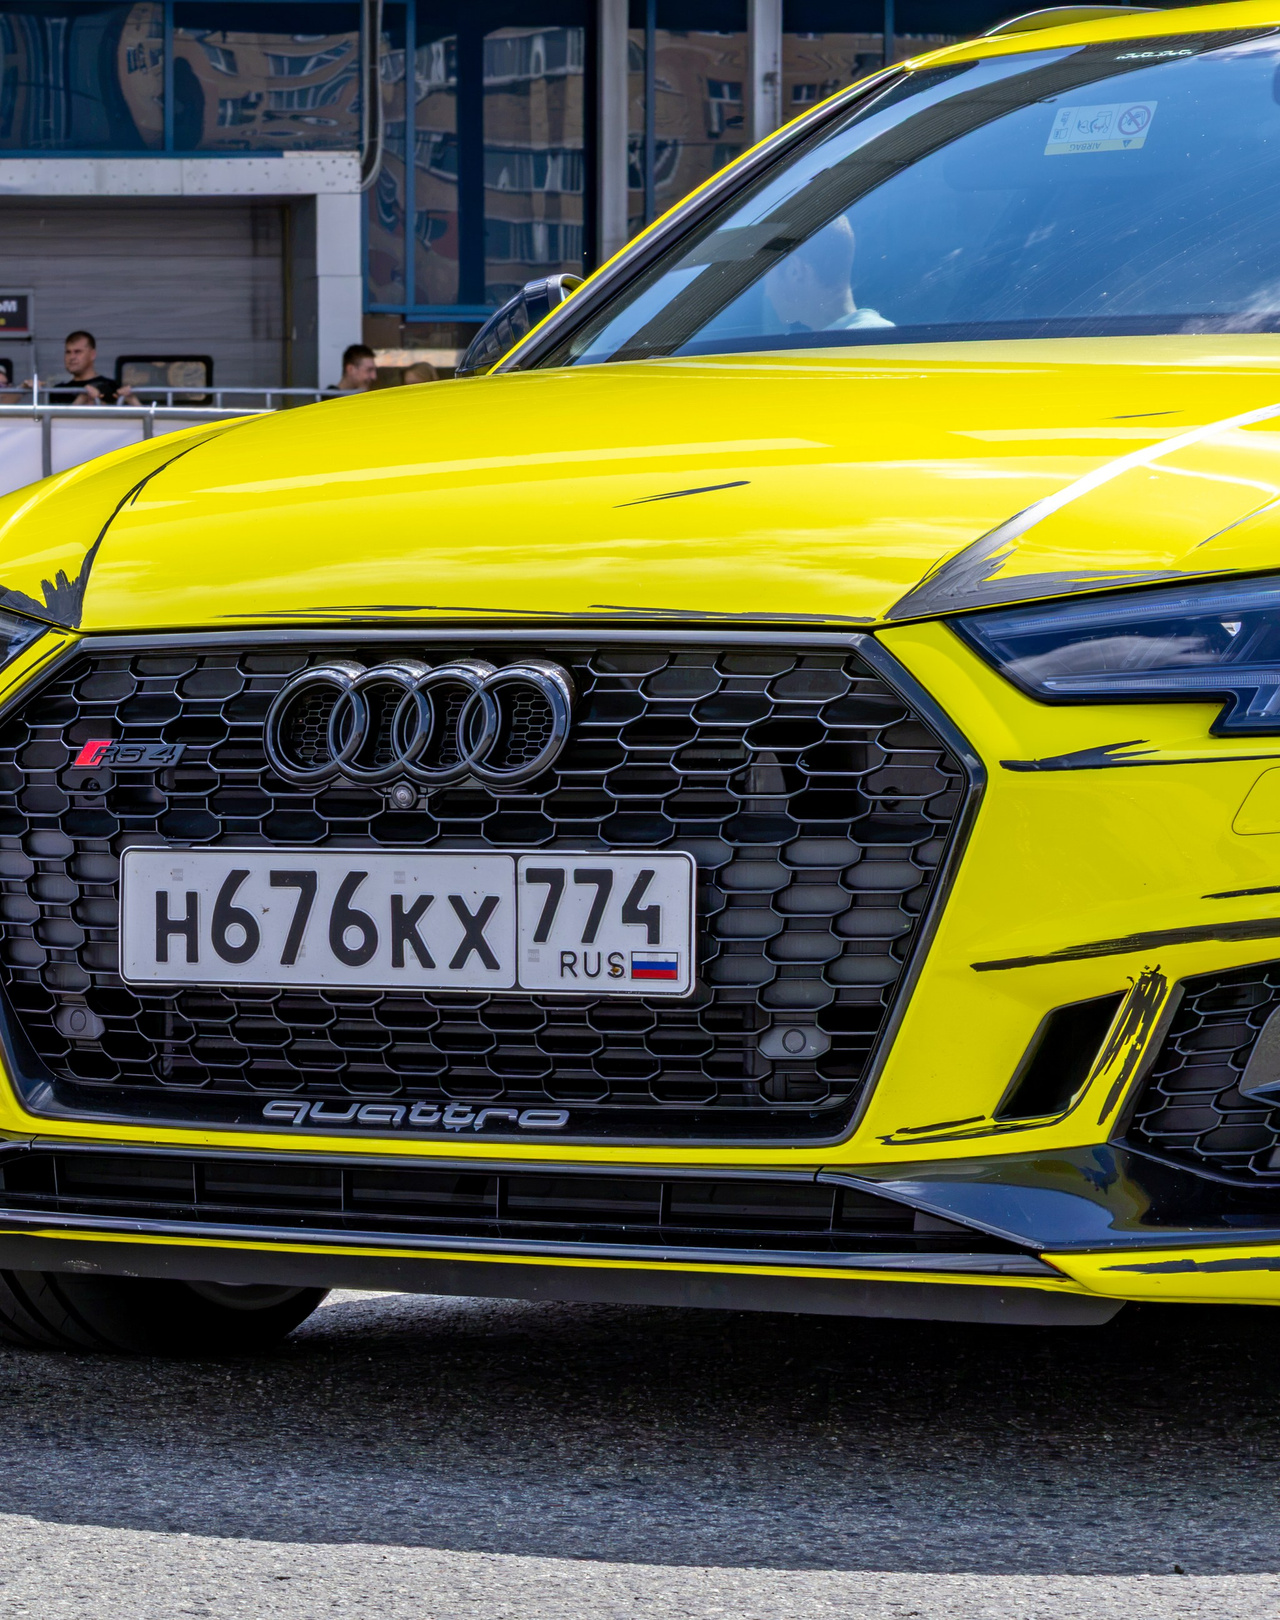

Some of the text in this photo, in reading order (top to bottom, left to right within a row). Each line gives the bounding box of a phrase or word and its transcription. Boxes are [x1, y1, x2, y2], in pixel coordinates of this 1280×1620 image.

[1069, 141, 1102, 151] AIRBAG
[525, 867, 662, 945] 774
[560, 950, 626, 979] RUS
[262, 1100, 570, 1129] quattro
